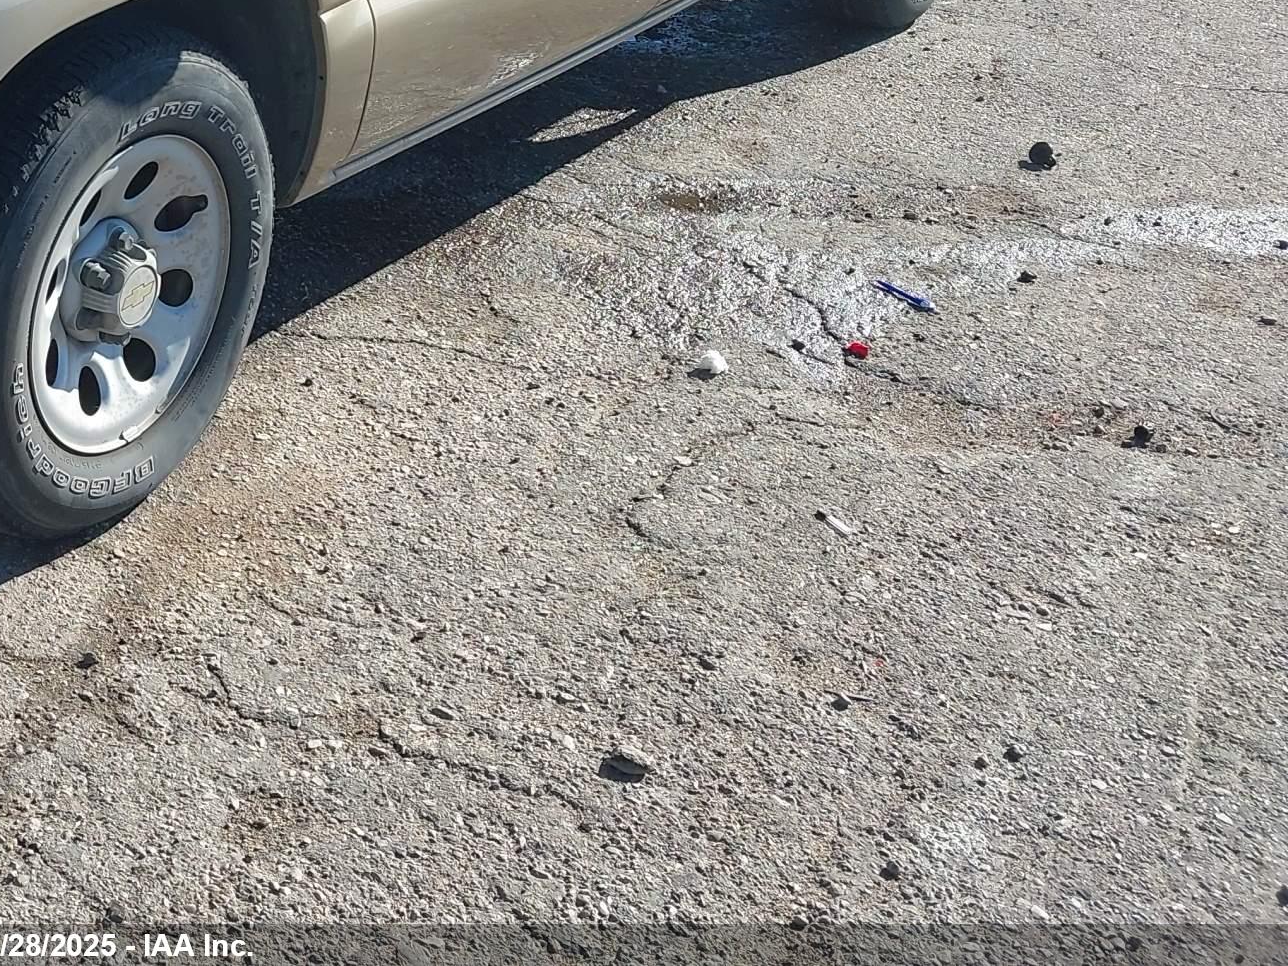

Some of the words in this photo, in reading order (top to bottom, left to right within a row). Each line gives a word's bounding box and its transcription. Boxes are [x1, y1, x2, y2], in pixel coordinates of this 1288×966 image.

[117, 100, 203, 141] Long
[206, 104, 258, 180] Trail
[247, 189, 264, 270] T/A
[12, 361, 156, 499] BFGoodrich
